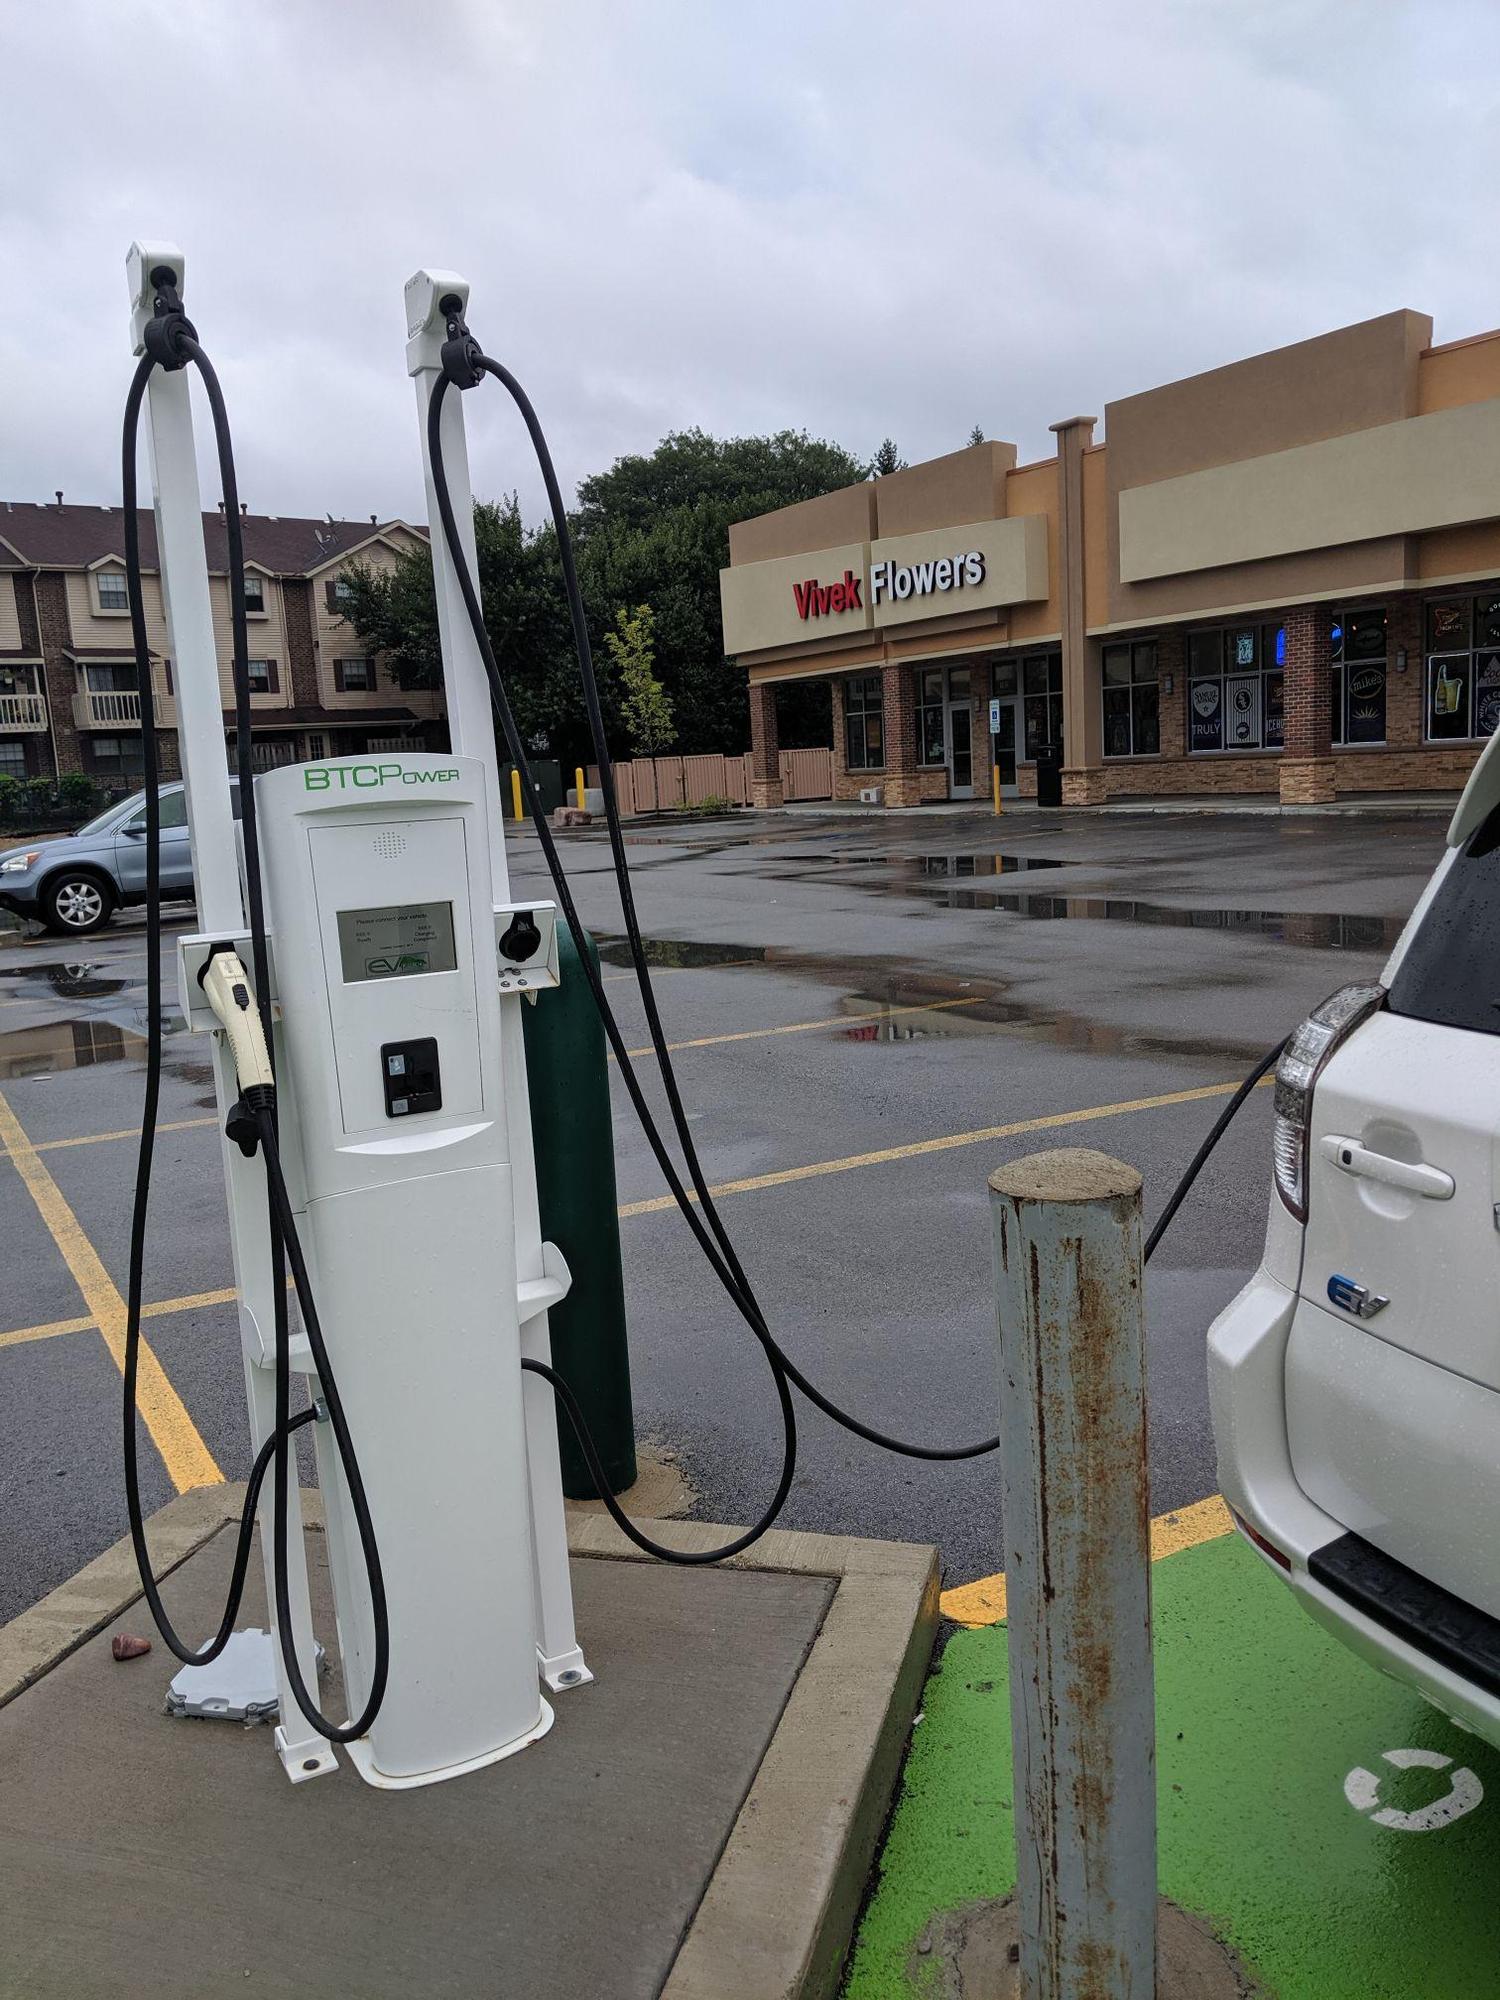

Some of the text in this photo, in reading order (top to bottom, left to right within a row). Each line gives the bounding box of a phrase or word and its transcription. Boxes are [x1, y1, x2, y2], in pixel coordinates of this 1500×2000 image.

[793, 551, 985, 620] Vivek Flowers
[1192, 723, 1221, 735] TRULY
